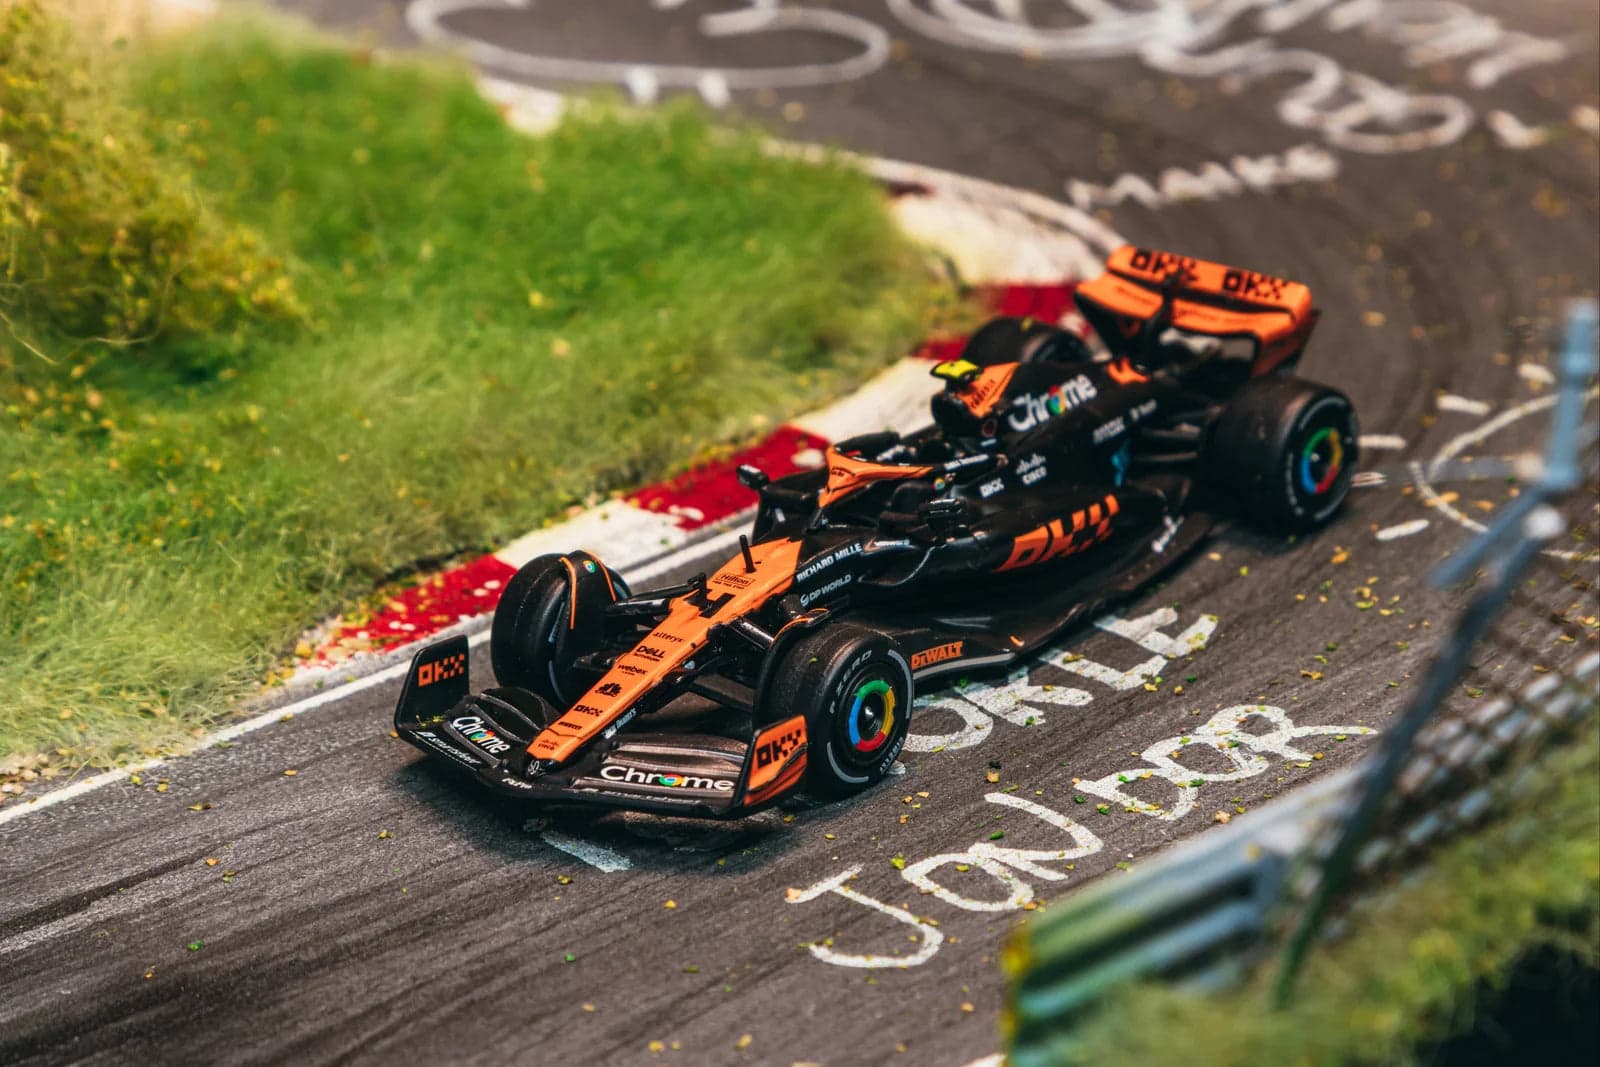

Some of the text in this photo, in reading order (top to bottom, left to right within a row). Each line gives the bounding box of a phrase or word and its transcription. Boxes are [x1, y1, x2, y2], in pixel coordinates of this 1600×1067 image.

[1222, 268, 1289, 301] OKX
[1008, 373, 1098, 432] Chrome
[796, 542, 863, 582] RICHARD MILLE
[808, 573, 853, 602] DP WORLD
[635, 645, 666, 659] DELL
[910, 640, 964, 671] DEWALT
[418, 653, 465, 687] OKX
[618, 663, 648, 675] webex
[835, 649, 873, 697] ZERO
[573, 704, 604, 717] OKX
[452, 716, 511, 754] Chrome
[600, 765, 735, 791] Chrome
